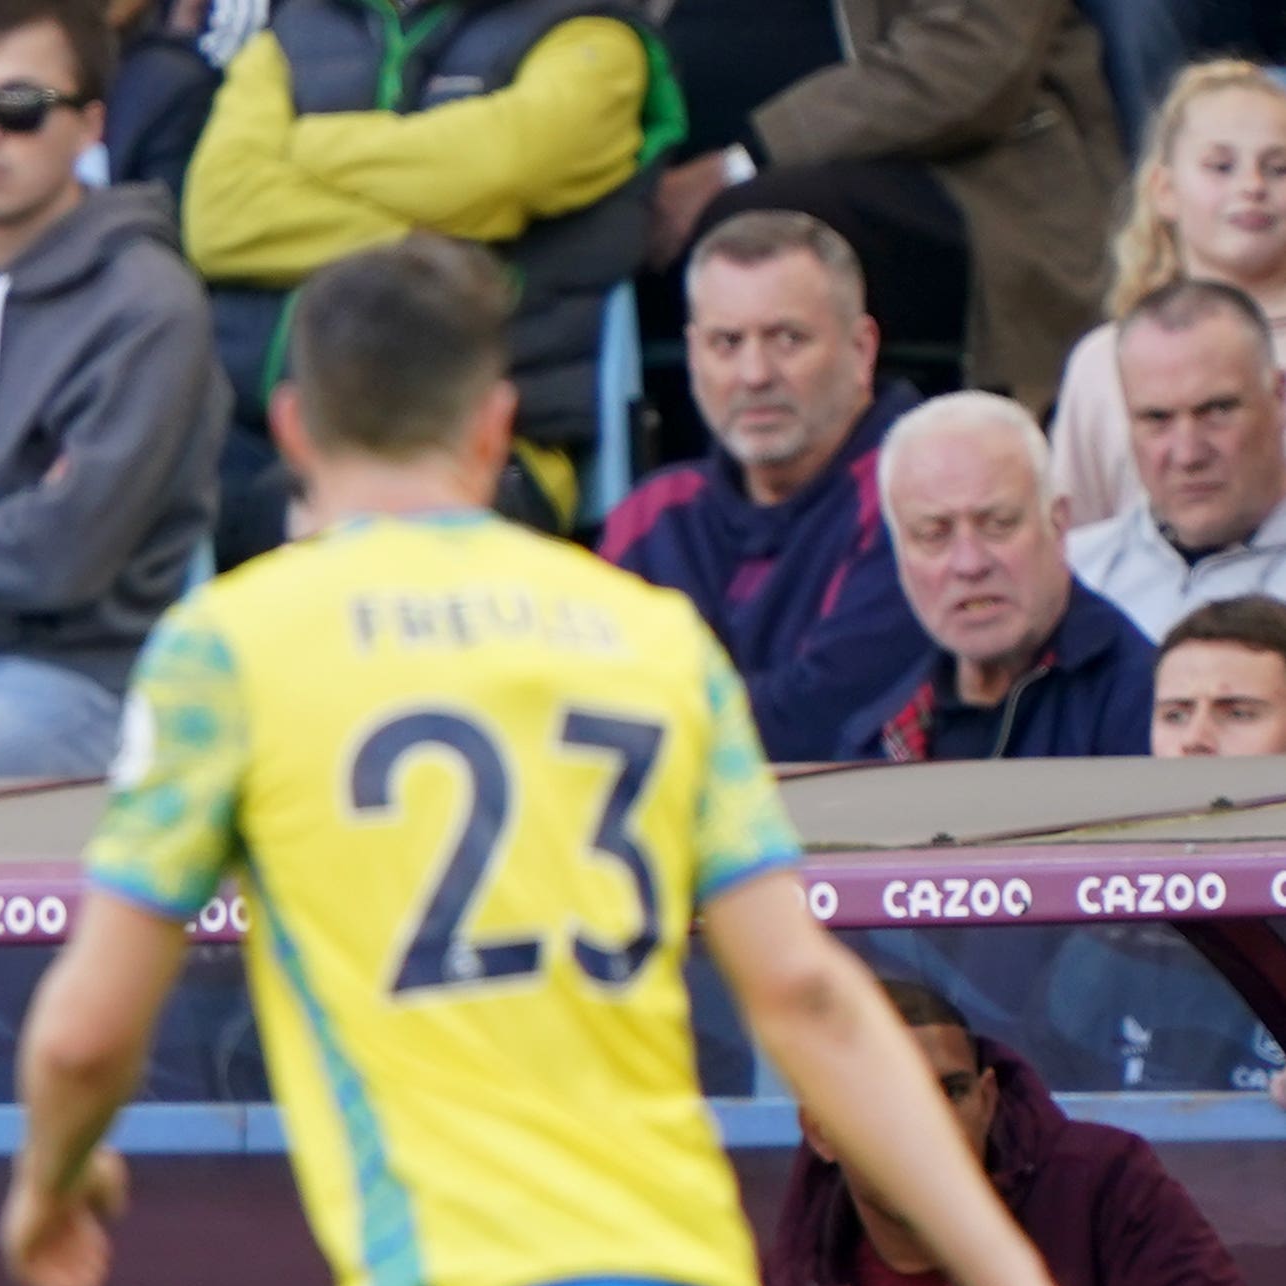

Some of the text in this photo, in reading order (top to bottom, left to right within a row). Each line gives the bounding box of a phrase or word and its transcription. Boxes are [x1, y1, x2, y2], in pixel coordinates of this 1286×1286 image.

[345, 704, 668, 998] 23
[882, 877, 1033, 918] CAZOO
[1076, 872, 1227, 915] CAZOO
